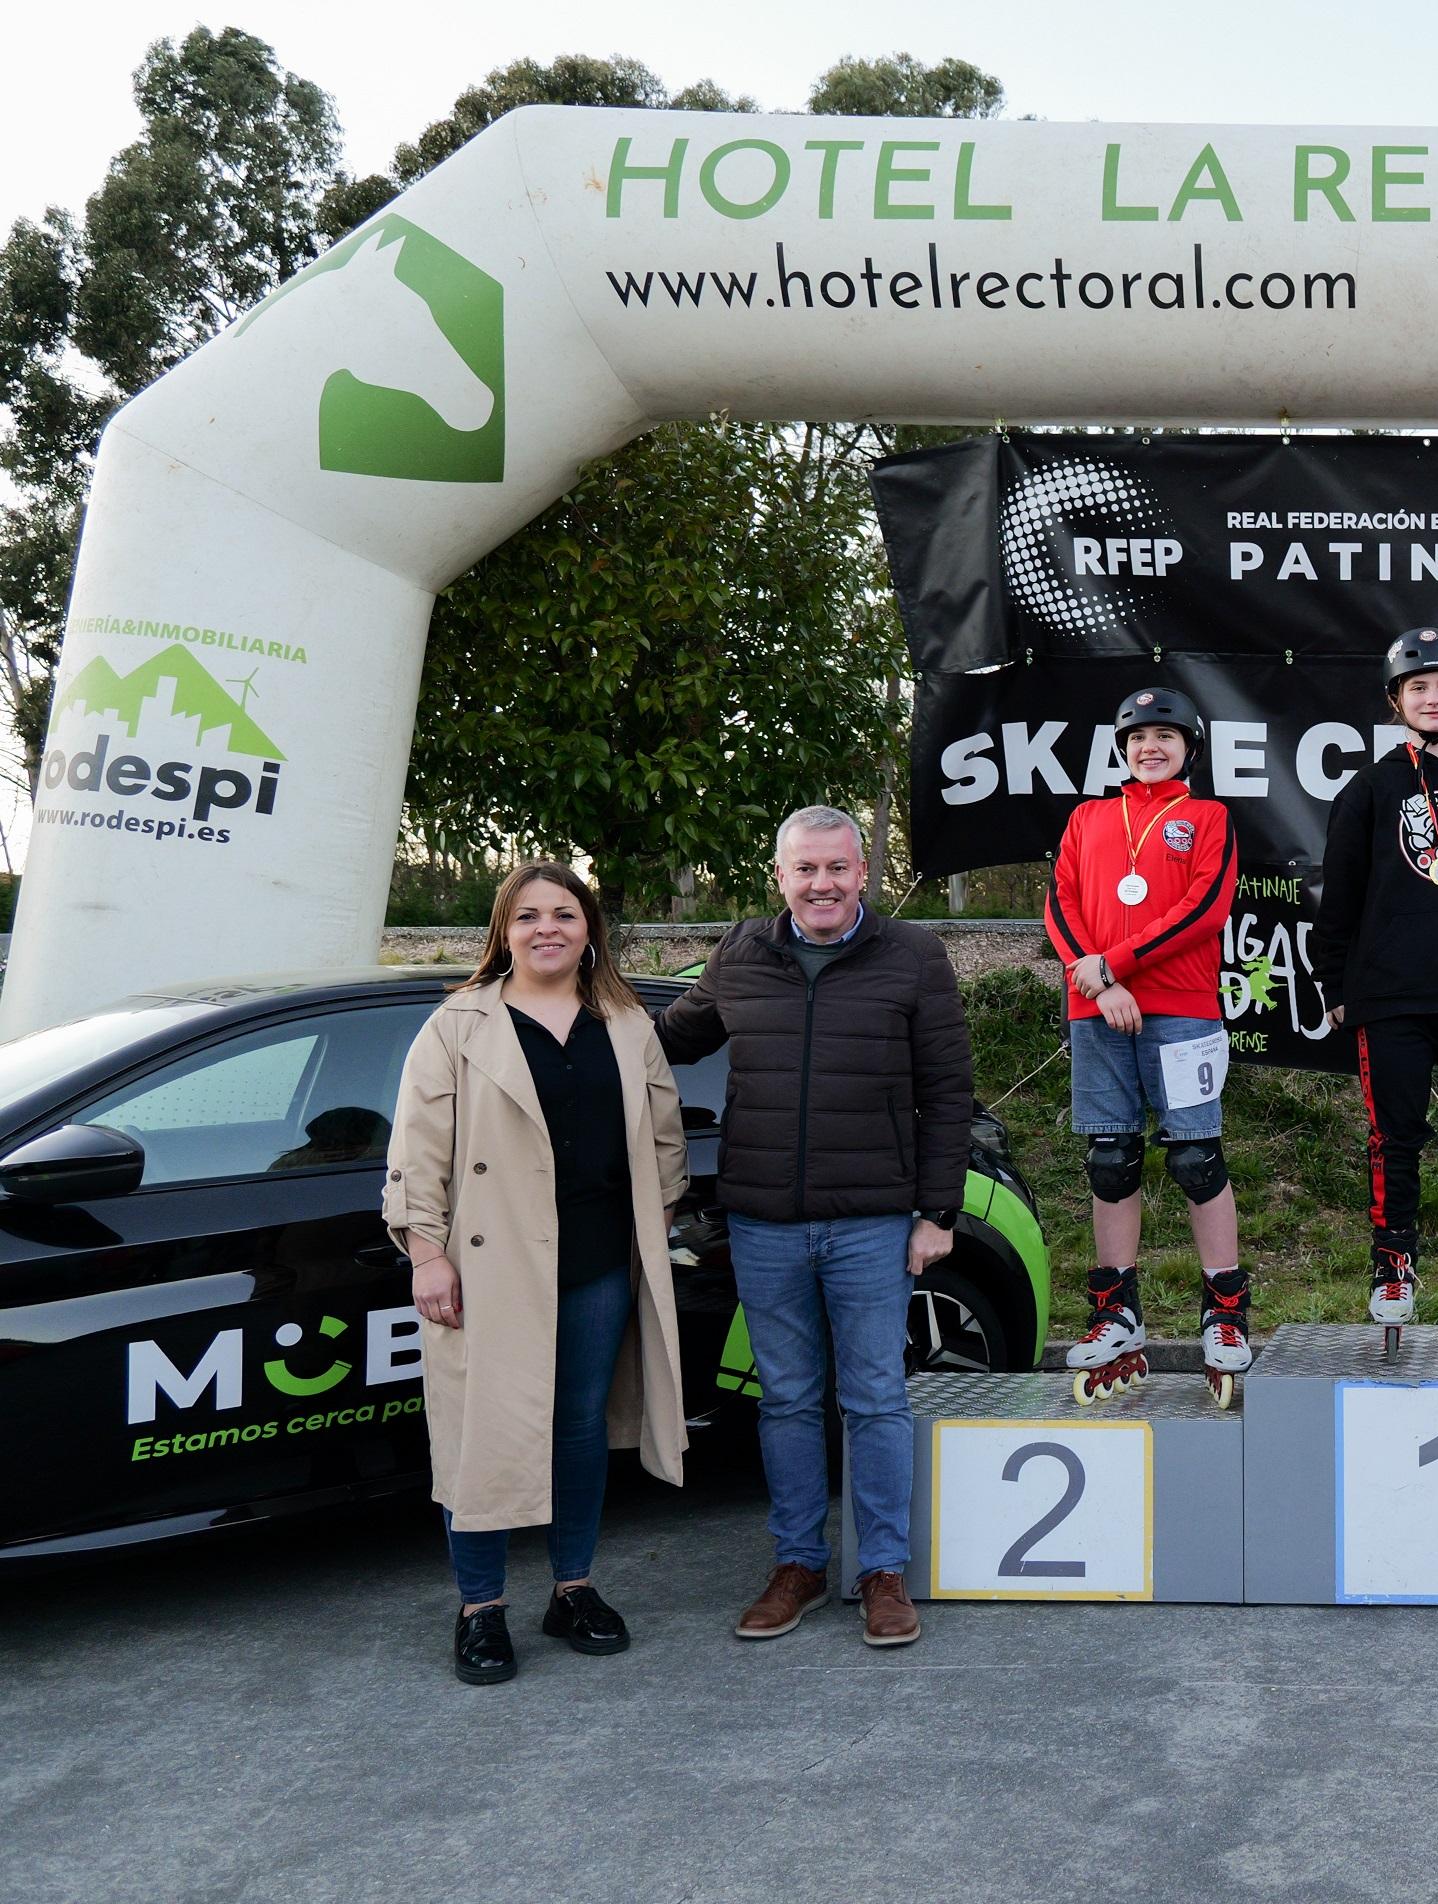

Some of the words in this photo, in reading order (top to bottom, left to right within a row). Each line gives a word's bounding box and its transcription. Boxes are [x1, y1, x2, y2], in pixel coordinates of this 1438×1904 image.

[605, 137, 1013, 220] HOTEL
[1101, 142, 1244, 222] LA
[605, 242, 1357, 310] www.hotelrectoral.com
[1227, 511, 1283, 529] REAL
[1288, 509, 1426, 531] FEDERACIÓN
[1072, 537, 1184, 577] RFEP
[42, 734, 281, 822] odespi
[940, 721, 1269, 805] SKAE
[37, 808, 231, 844] www.rodespi.es
[1197, 1062, 1214, 1096] 9
[131, 1417, 278, 1462] Estamos
[286, 1401, 374, 1434] cerca
[381, 1396, 423, 1423] pa
[997, 1441, 1087, 1579] 2
